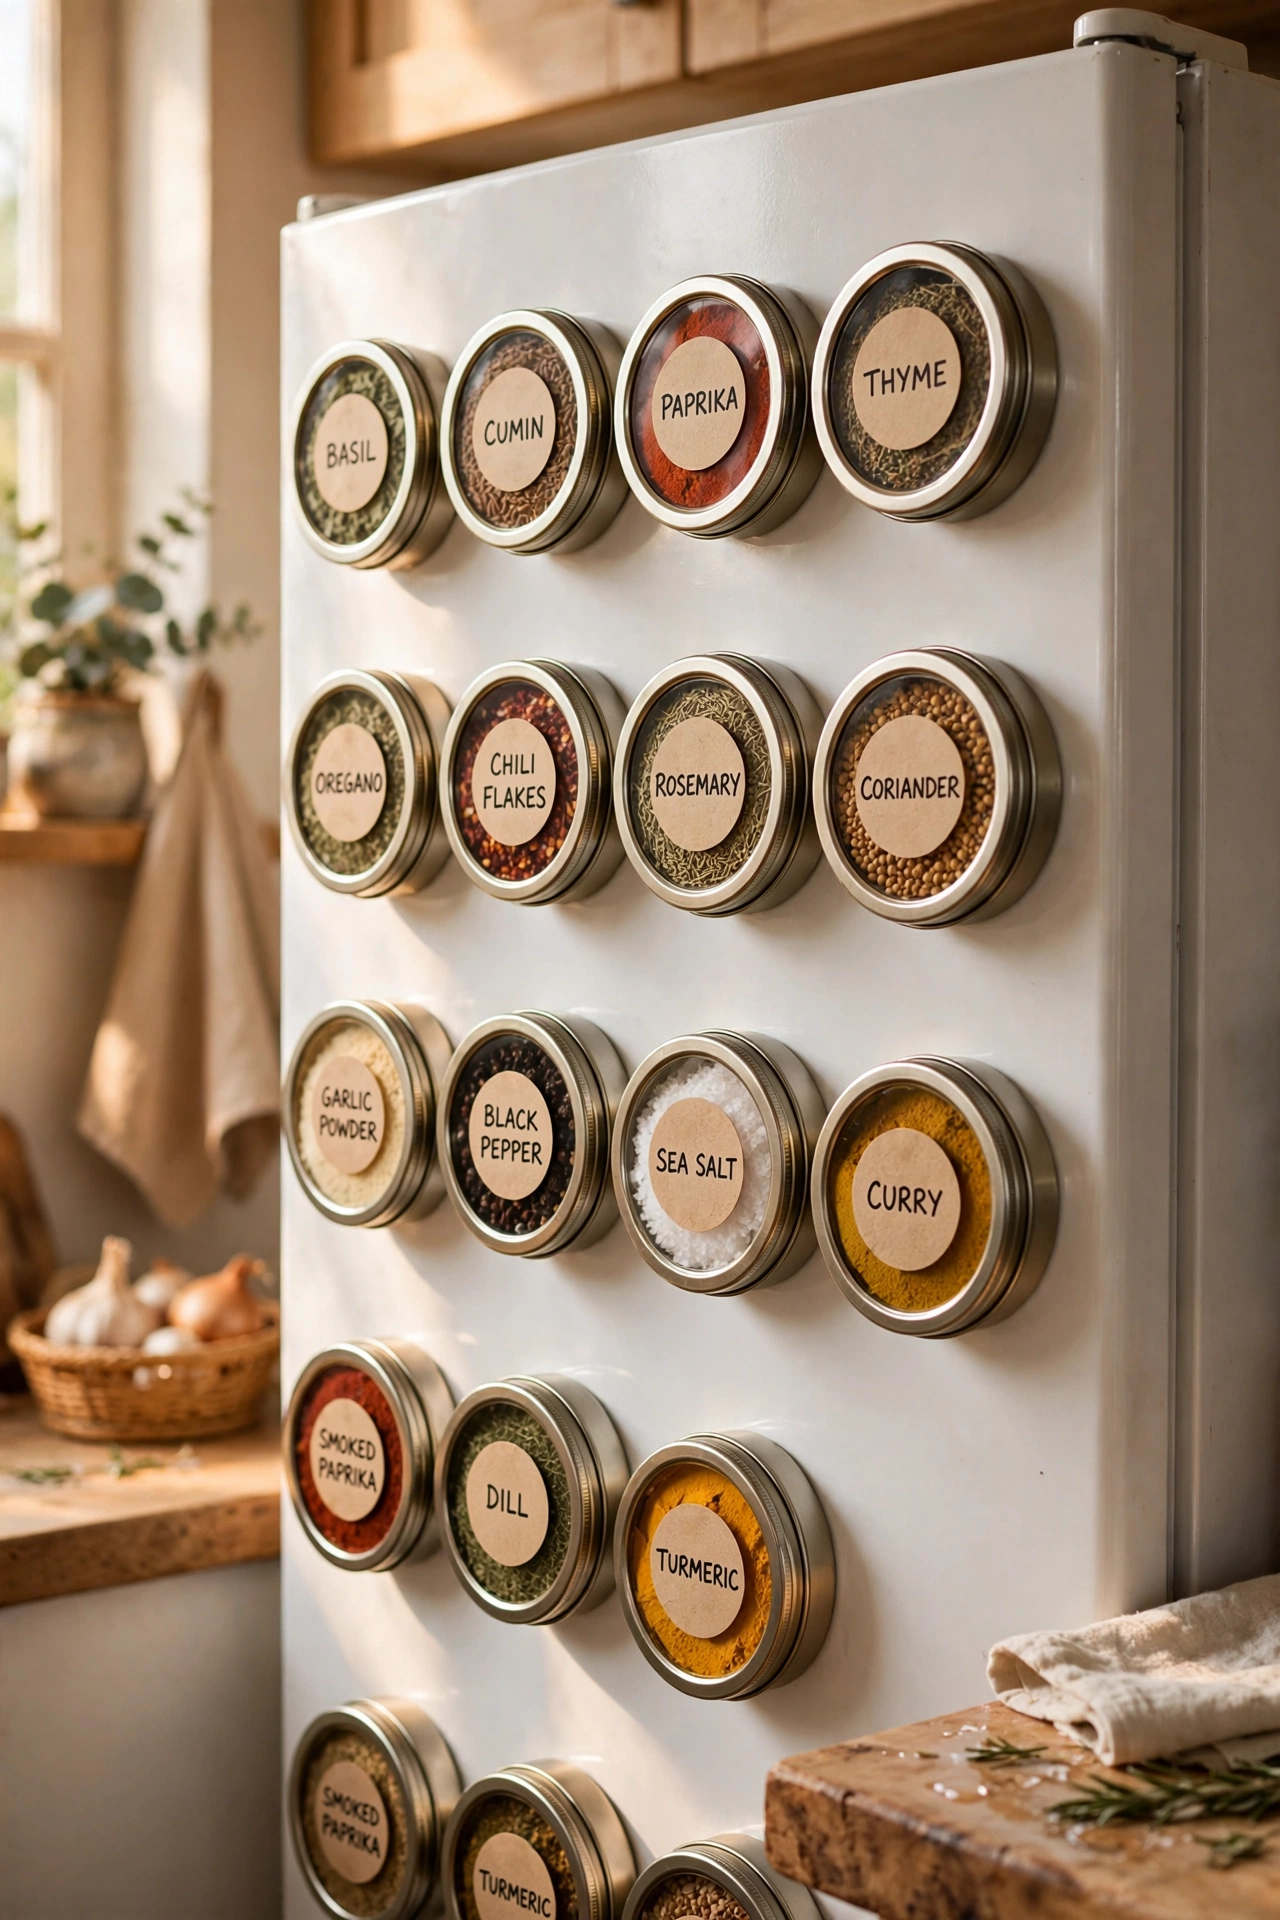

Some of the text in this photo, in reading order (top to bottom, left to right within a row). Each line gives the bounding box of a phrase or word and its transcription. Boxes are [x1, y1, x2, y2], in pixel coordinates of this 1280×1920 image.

[862, 359, 947, 397] THYME
[661, 385, 739, 421] PAPRIKA
[484, 414, 544, 446] CUMIN
[327, 440, 377, 469] BASIL
[490, 752, 535, 776] CHILI
[316, 772, 383, 794] OREGANO
[483, 785, 546, 809] FLAKES
[655, 773, 741, 797] ROSEMARY
[860, 775, 960, 801] CORIANDER
[322, 1086, 372, 1112] GARLIC
[319, 1114, 378, 1142] POWDER
[484, 1103, 539, 1132] BLACK
[481, 1135, 543, 1166] PEPPER
[656, 1147, 738, 1181] SEA SALT
[867, 1180, 943, 1218] CURRY
[319, 1428, 376, 1460] SMOKED
[319, 1457, 377, 1492] PAPRIKA
[486, 1483, 529, 1519] DILL
[656, 1547, 740, 1592] TURMERIC
[322, 1786, 380, 1827] SMOKED
[321, 1813, 381, 1859] PAPRIKA
[478, 1869, 553, 1918] TURMERIC
